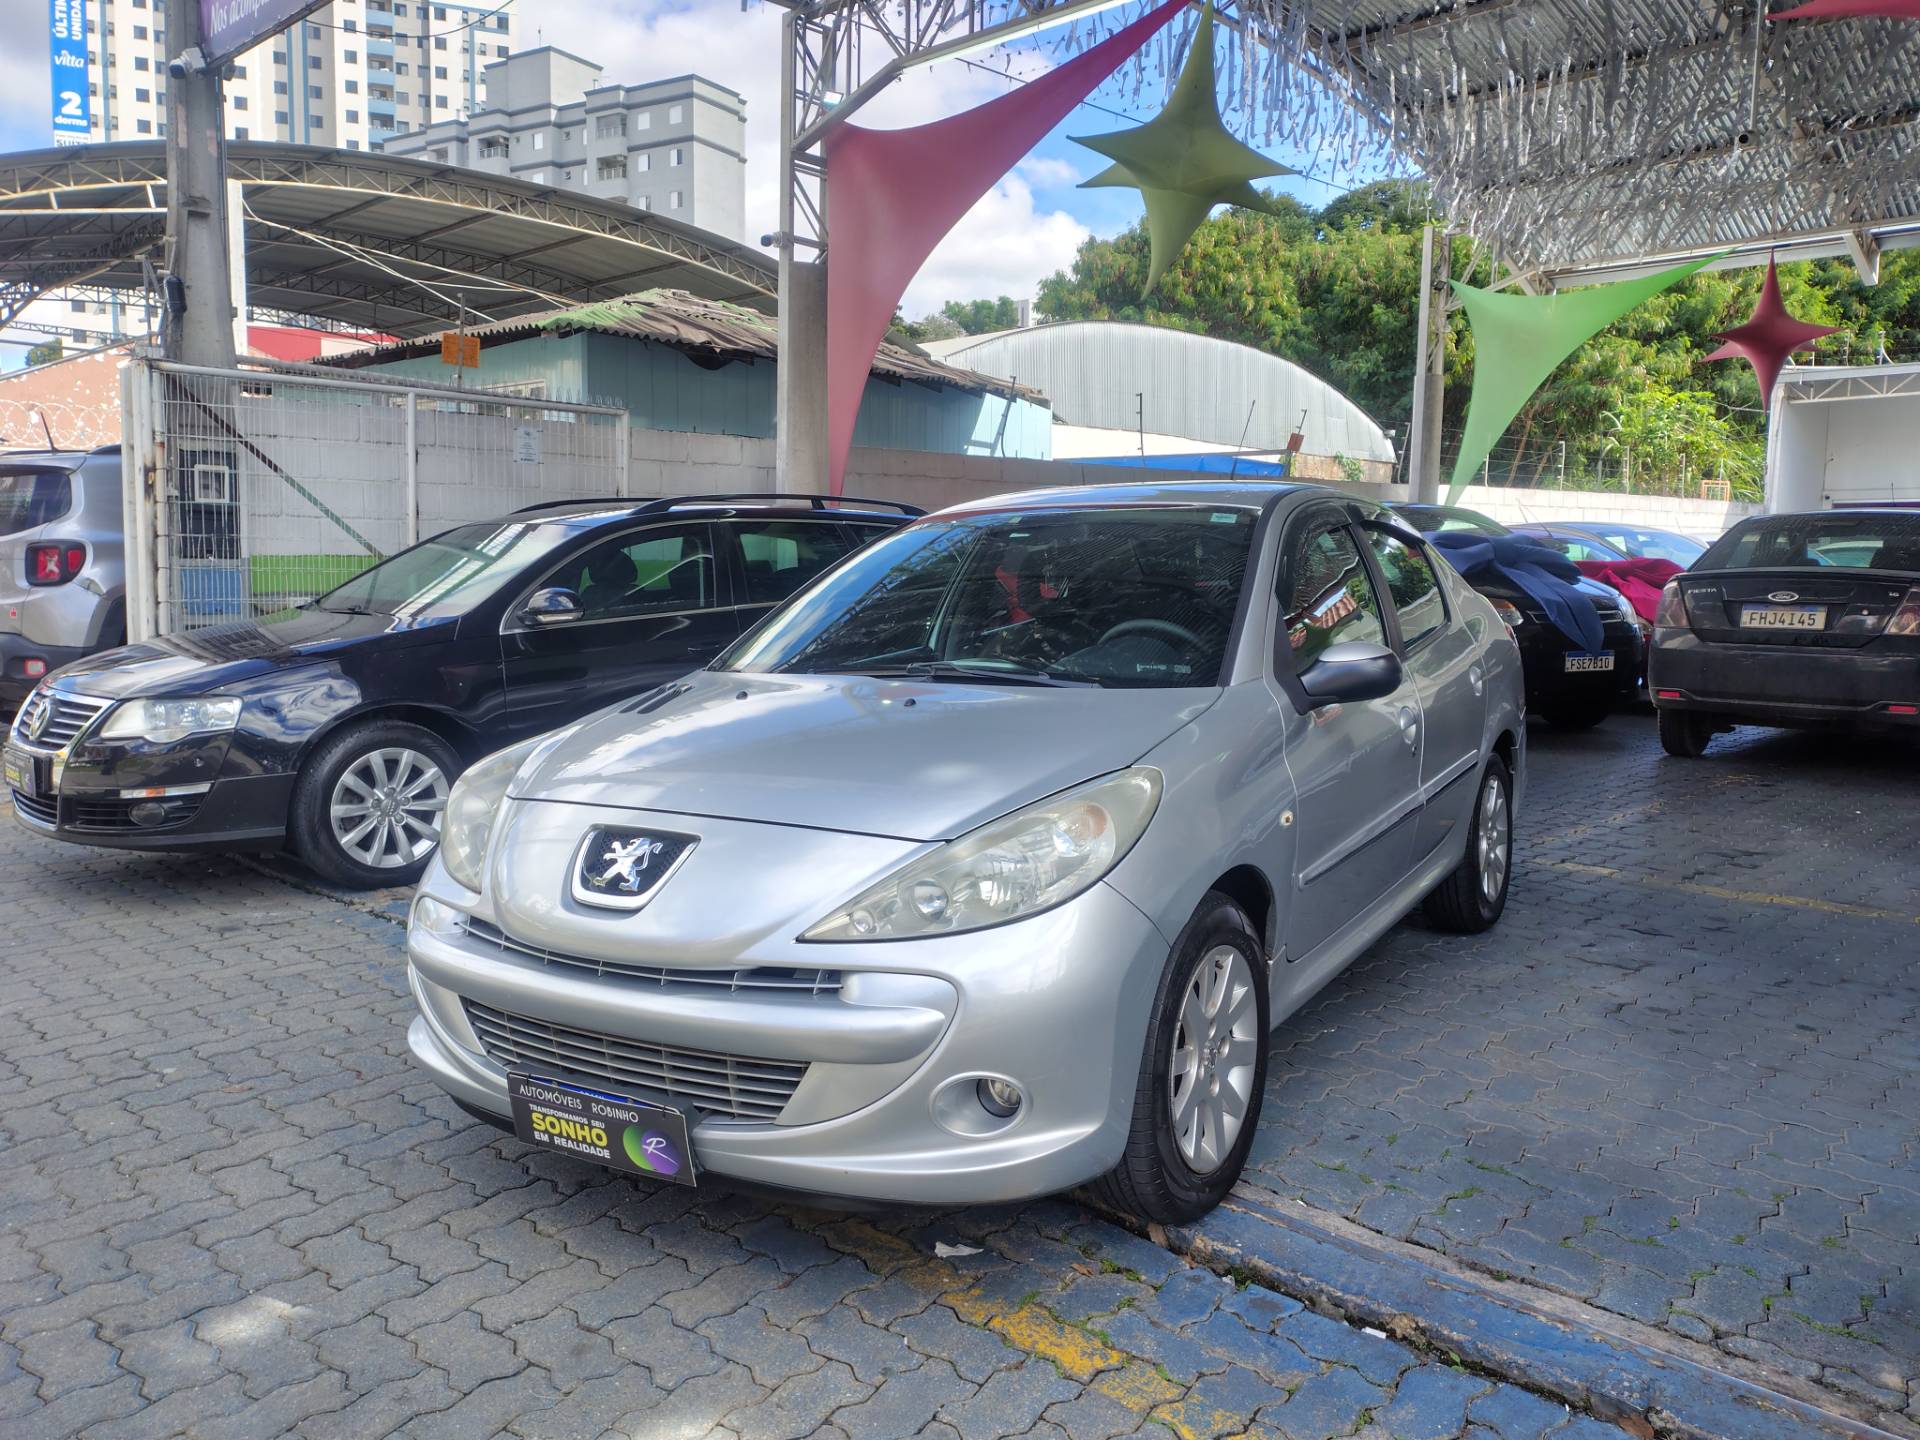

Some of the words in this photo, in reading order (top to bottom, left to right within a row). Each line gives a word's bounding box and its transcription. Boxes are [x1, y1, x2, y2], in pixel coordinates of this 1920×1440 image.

[210, 2, 227, 38] Nos
[230, 0, 269, 25] acomp
[54, 50, 85, 68] vitta
[60, 91, 82, 116] 2
[1749, 611, 1817, 627] FHJ4I45
[520, 1084, 583, 1110] AUTOMÓVEIS
[591, 1102, 639, 1123] ROBINHO
[528, 1103, 589, 1125] TRANSFORMAMOS
[590, 1119, 605, 1129] SEU
[531, 1112, 608, 1148] SONHO
[533, 1130, 550, 1143] EM
[553, 1135, 611, 1159] REALIDADE
